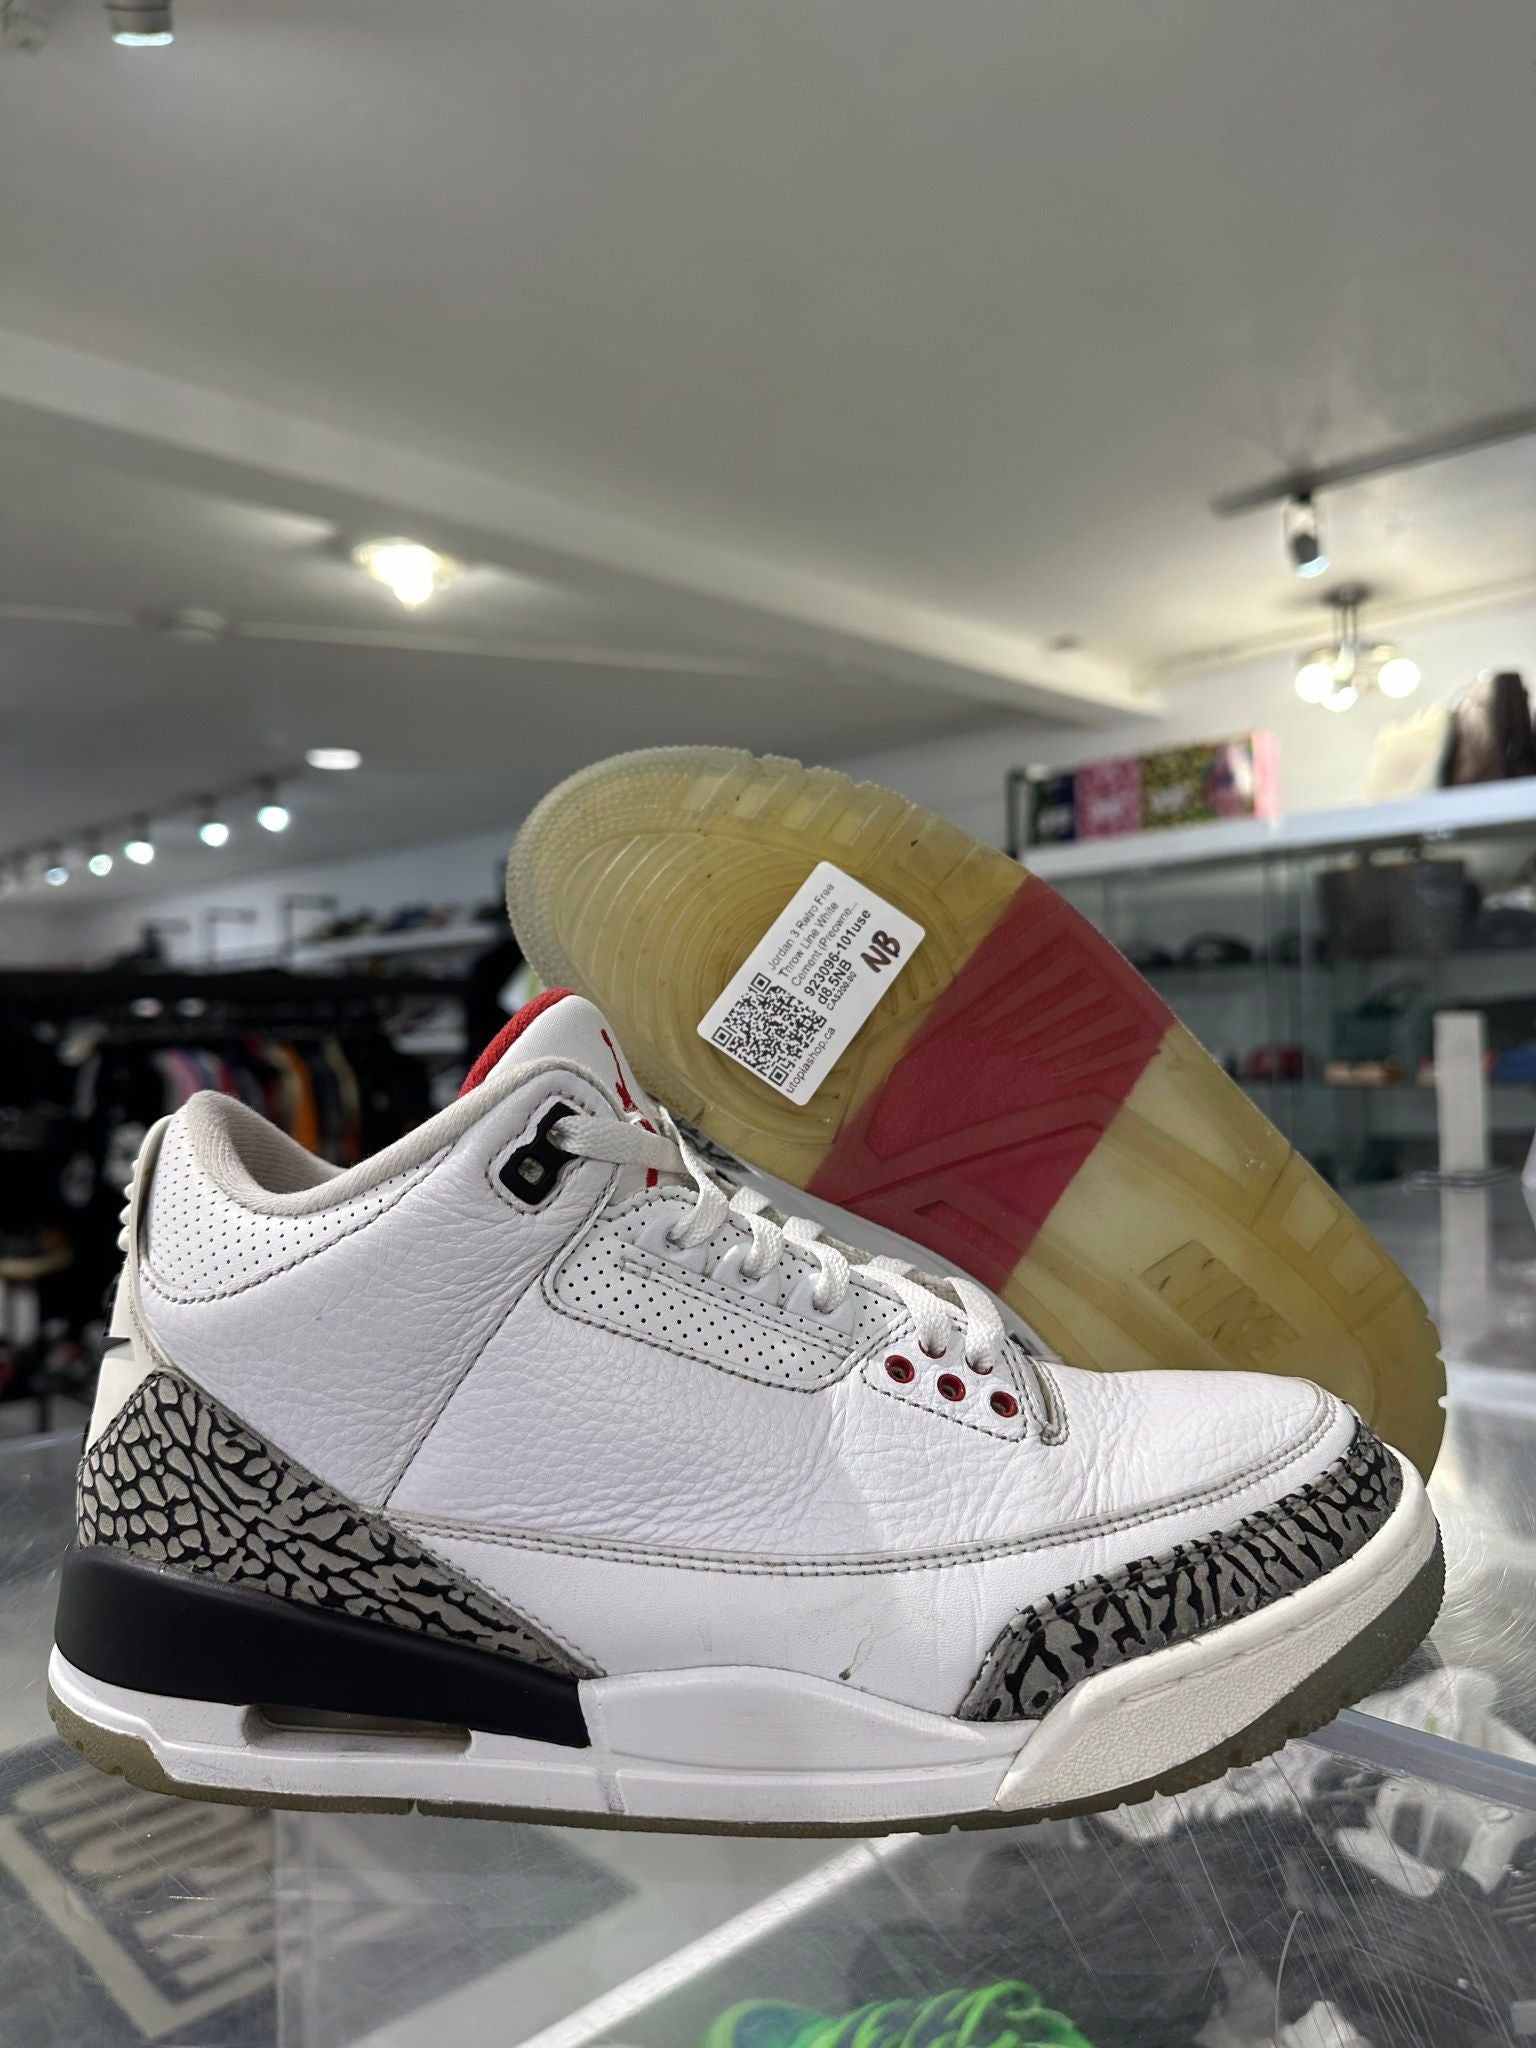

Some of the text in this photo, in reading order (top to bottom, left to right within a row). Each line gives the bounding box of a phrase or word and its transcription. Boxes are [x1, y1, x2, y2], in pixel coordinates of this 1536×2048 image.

[768, 884, 834, 971] Jordan 3 Retro Free
[778, 902, 838, 978] Throw Line White
[803, 909, 871, 997] 923096-101use
[860, 930, 901, 973] NB
[791, 950, 822, 987] Cement
[817, 959, 852, 1005] d8.5NB
[786, 1027, 836, 1094] utopiashop.ca
